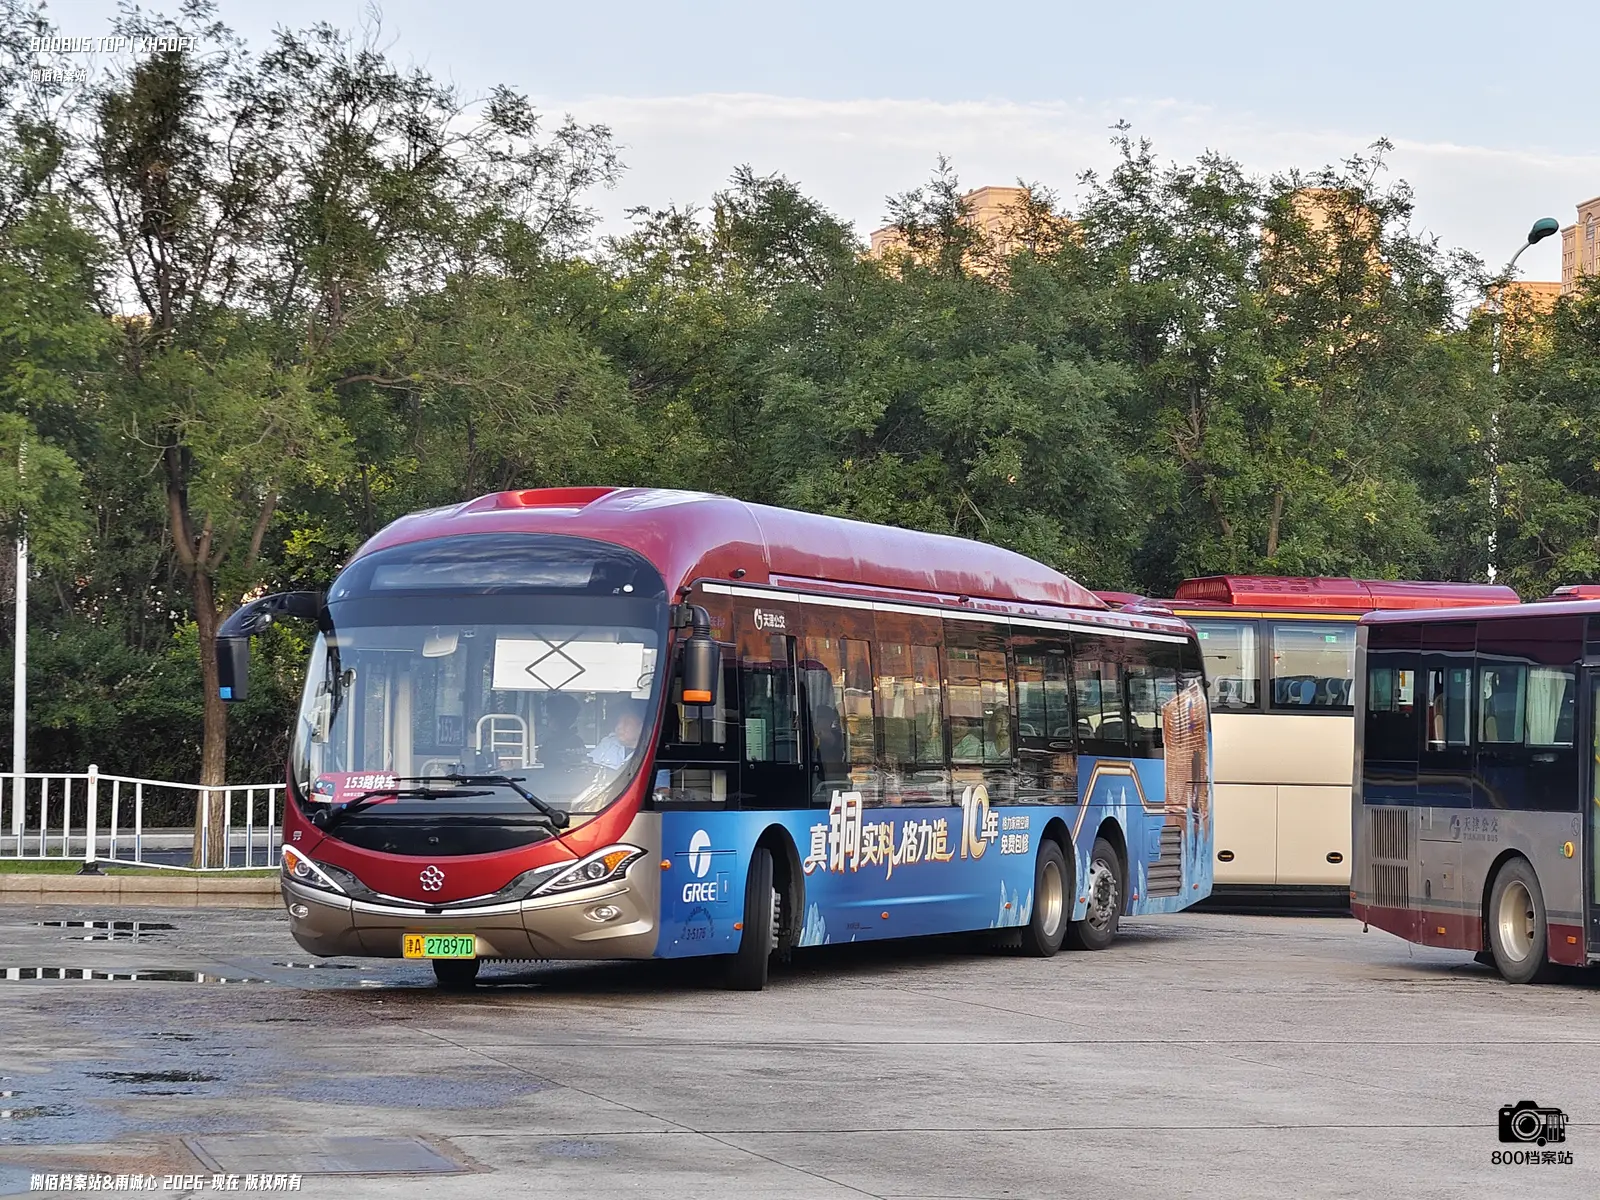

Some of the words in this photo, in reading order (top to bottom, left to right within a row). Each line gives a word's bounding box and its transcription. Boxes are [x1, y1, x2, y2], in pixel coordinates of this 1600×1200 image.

[763, 613, 786, 629] 天津公交
[343, 774, 397, 790] 153路快车
[1463, 816, 1499, 832] 天津公交
[1000, 833, 1030, 855] 免费包修
[682, 882, 717, 903] GREE
